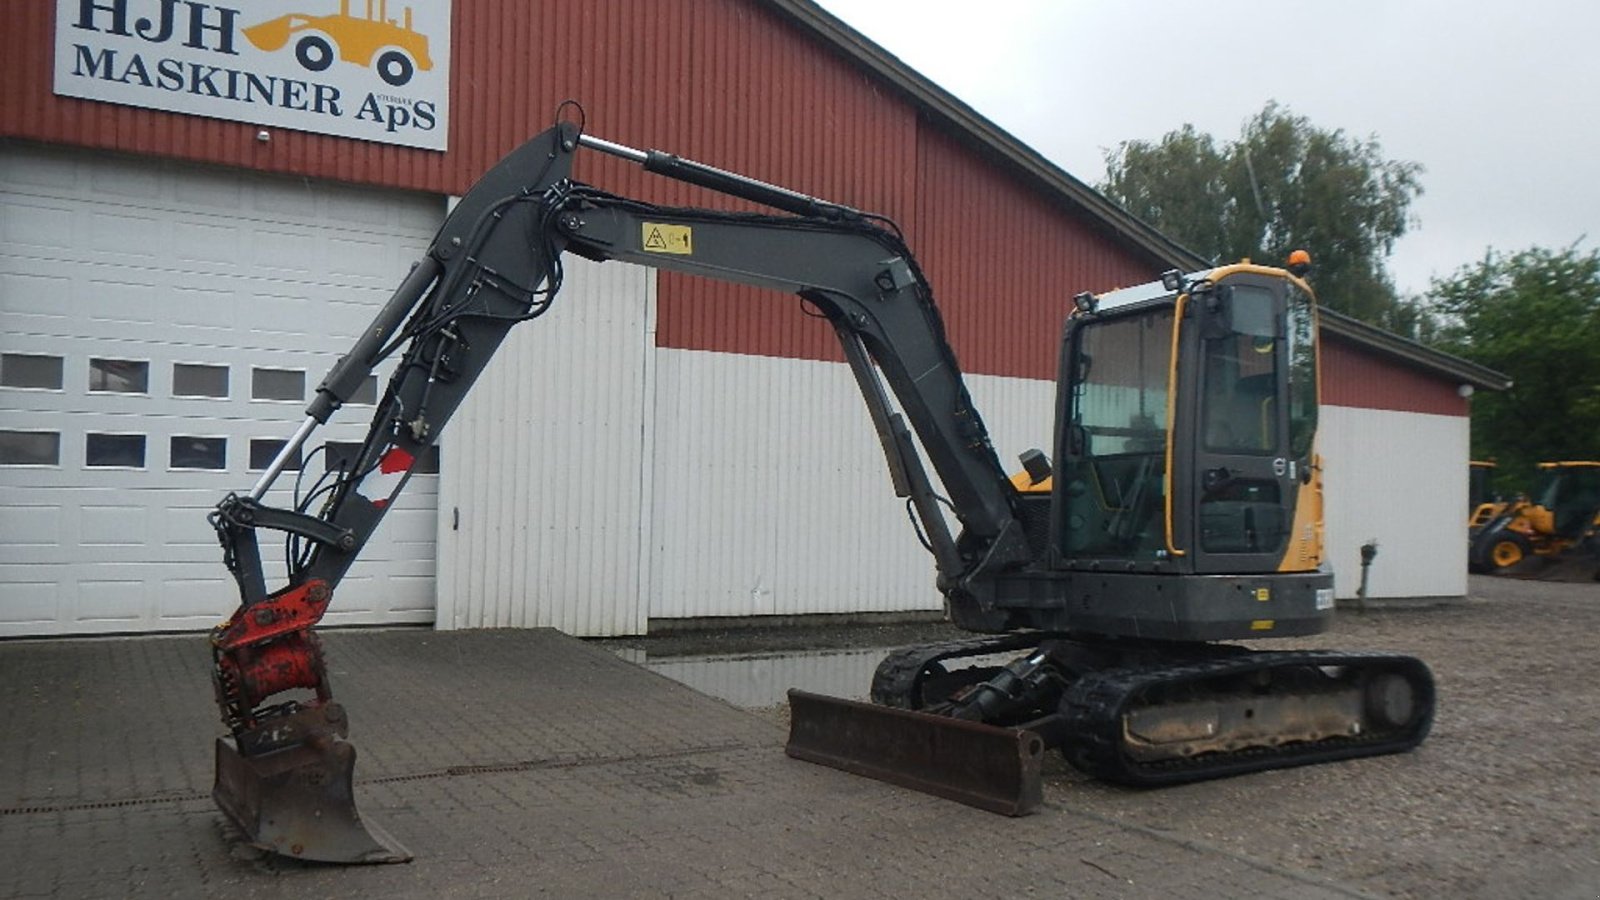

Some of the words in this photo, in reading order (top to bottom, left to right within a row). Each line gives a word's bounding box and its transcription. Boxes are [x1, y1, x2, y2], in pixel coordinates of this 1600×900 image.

[72, 0, 240, 55] HJH
[72, 44, 342, 117] MASKINER
[354, 92, 435, 132] ApS
